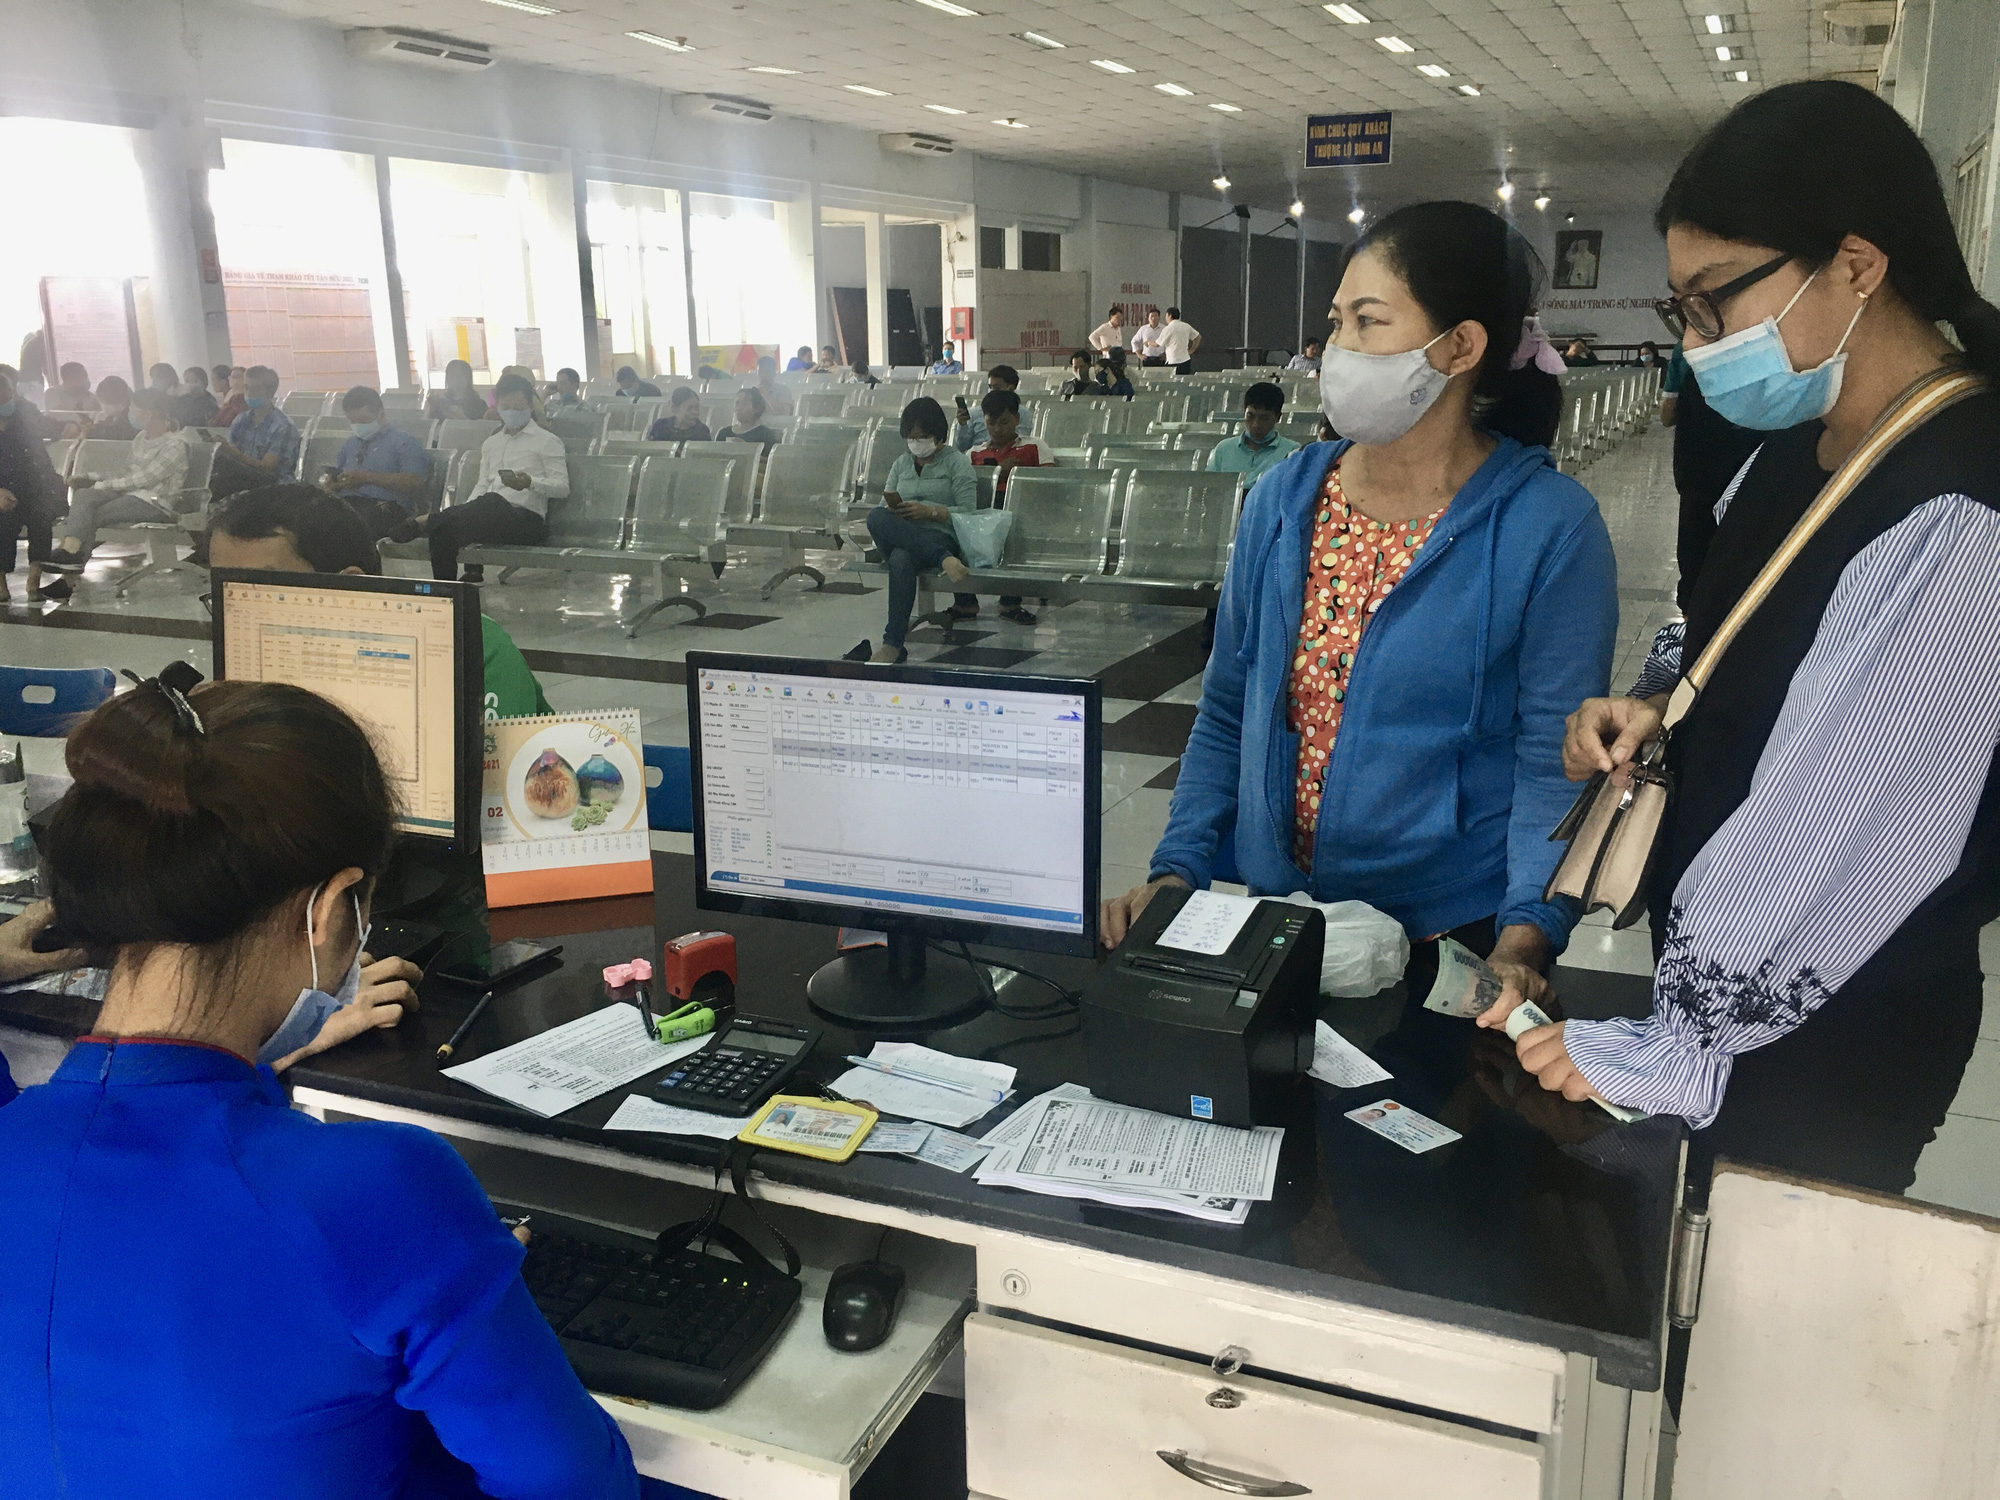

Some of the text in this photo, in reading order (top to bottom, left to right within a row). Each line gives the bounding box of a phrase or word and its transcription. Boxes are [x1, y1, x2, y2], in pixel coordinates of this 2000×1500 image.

[1310, 120, 1388, 139] KÍNH CHÚC QUÝ KHÁCH
[1314, 140, 1383, 159] THƯỢNG LỘ BÌNH AN
[1587, 298, 1616, 310] TRONG
[1616, 297, 1629, 311] SỰ
[487, 806, 504, 818] 02
